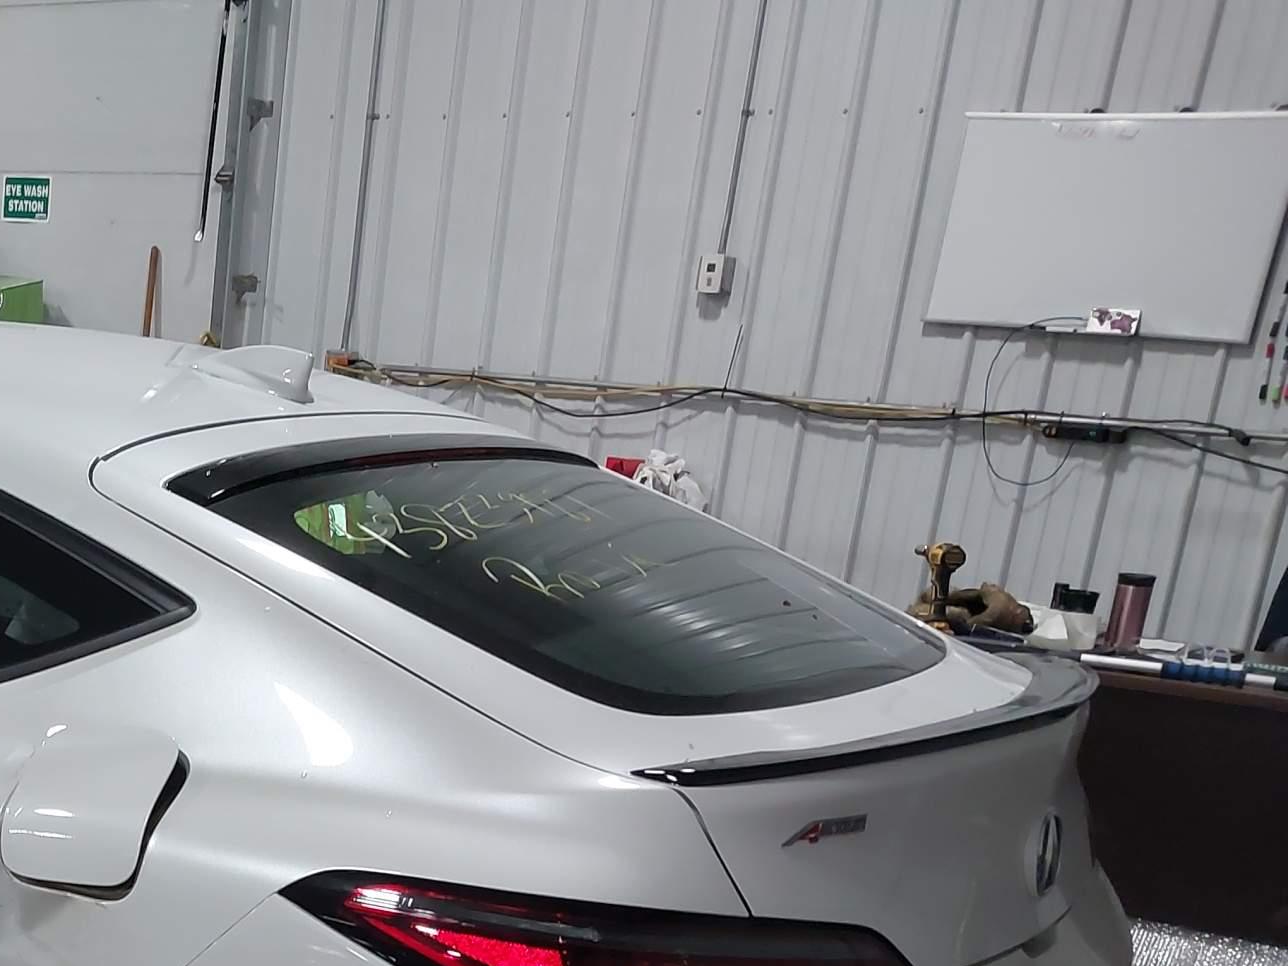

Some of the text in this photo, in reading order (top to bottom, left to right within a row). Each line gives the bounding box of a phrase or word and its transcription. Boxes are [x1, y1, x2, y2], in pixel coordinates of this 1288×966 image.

[5, 184, 49, 198] EYE WASH
[8, 199, 44, 213] STATION
